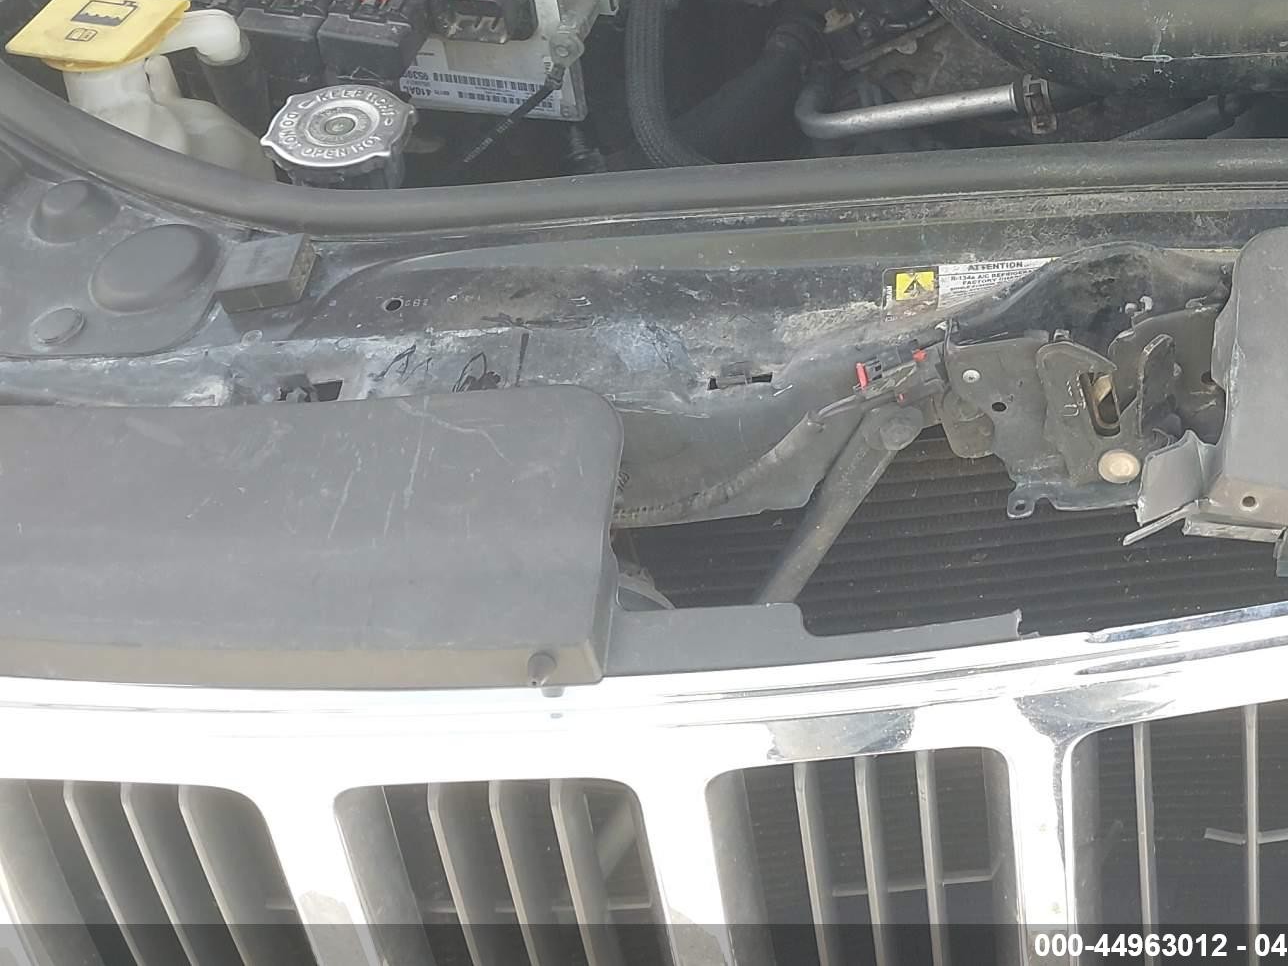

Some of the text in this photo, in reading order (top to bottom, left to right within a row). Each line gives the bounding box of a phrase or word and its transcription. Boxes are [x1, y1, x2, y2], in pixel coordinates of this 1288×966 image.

[316, 89, 397, 117] KEEP TIGHT
[279, 111, 301, 128] DO
[279, 128, 302, 150] NOT
[350, 135, 382, 153] HOT
[301, 147, 349, 159] OPEN
[967, 261, 1023, 272] ATTENTION
[962, 278, 997, 286] FACTORY
